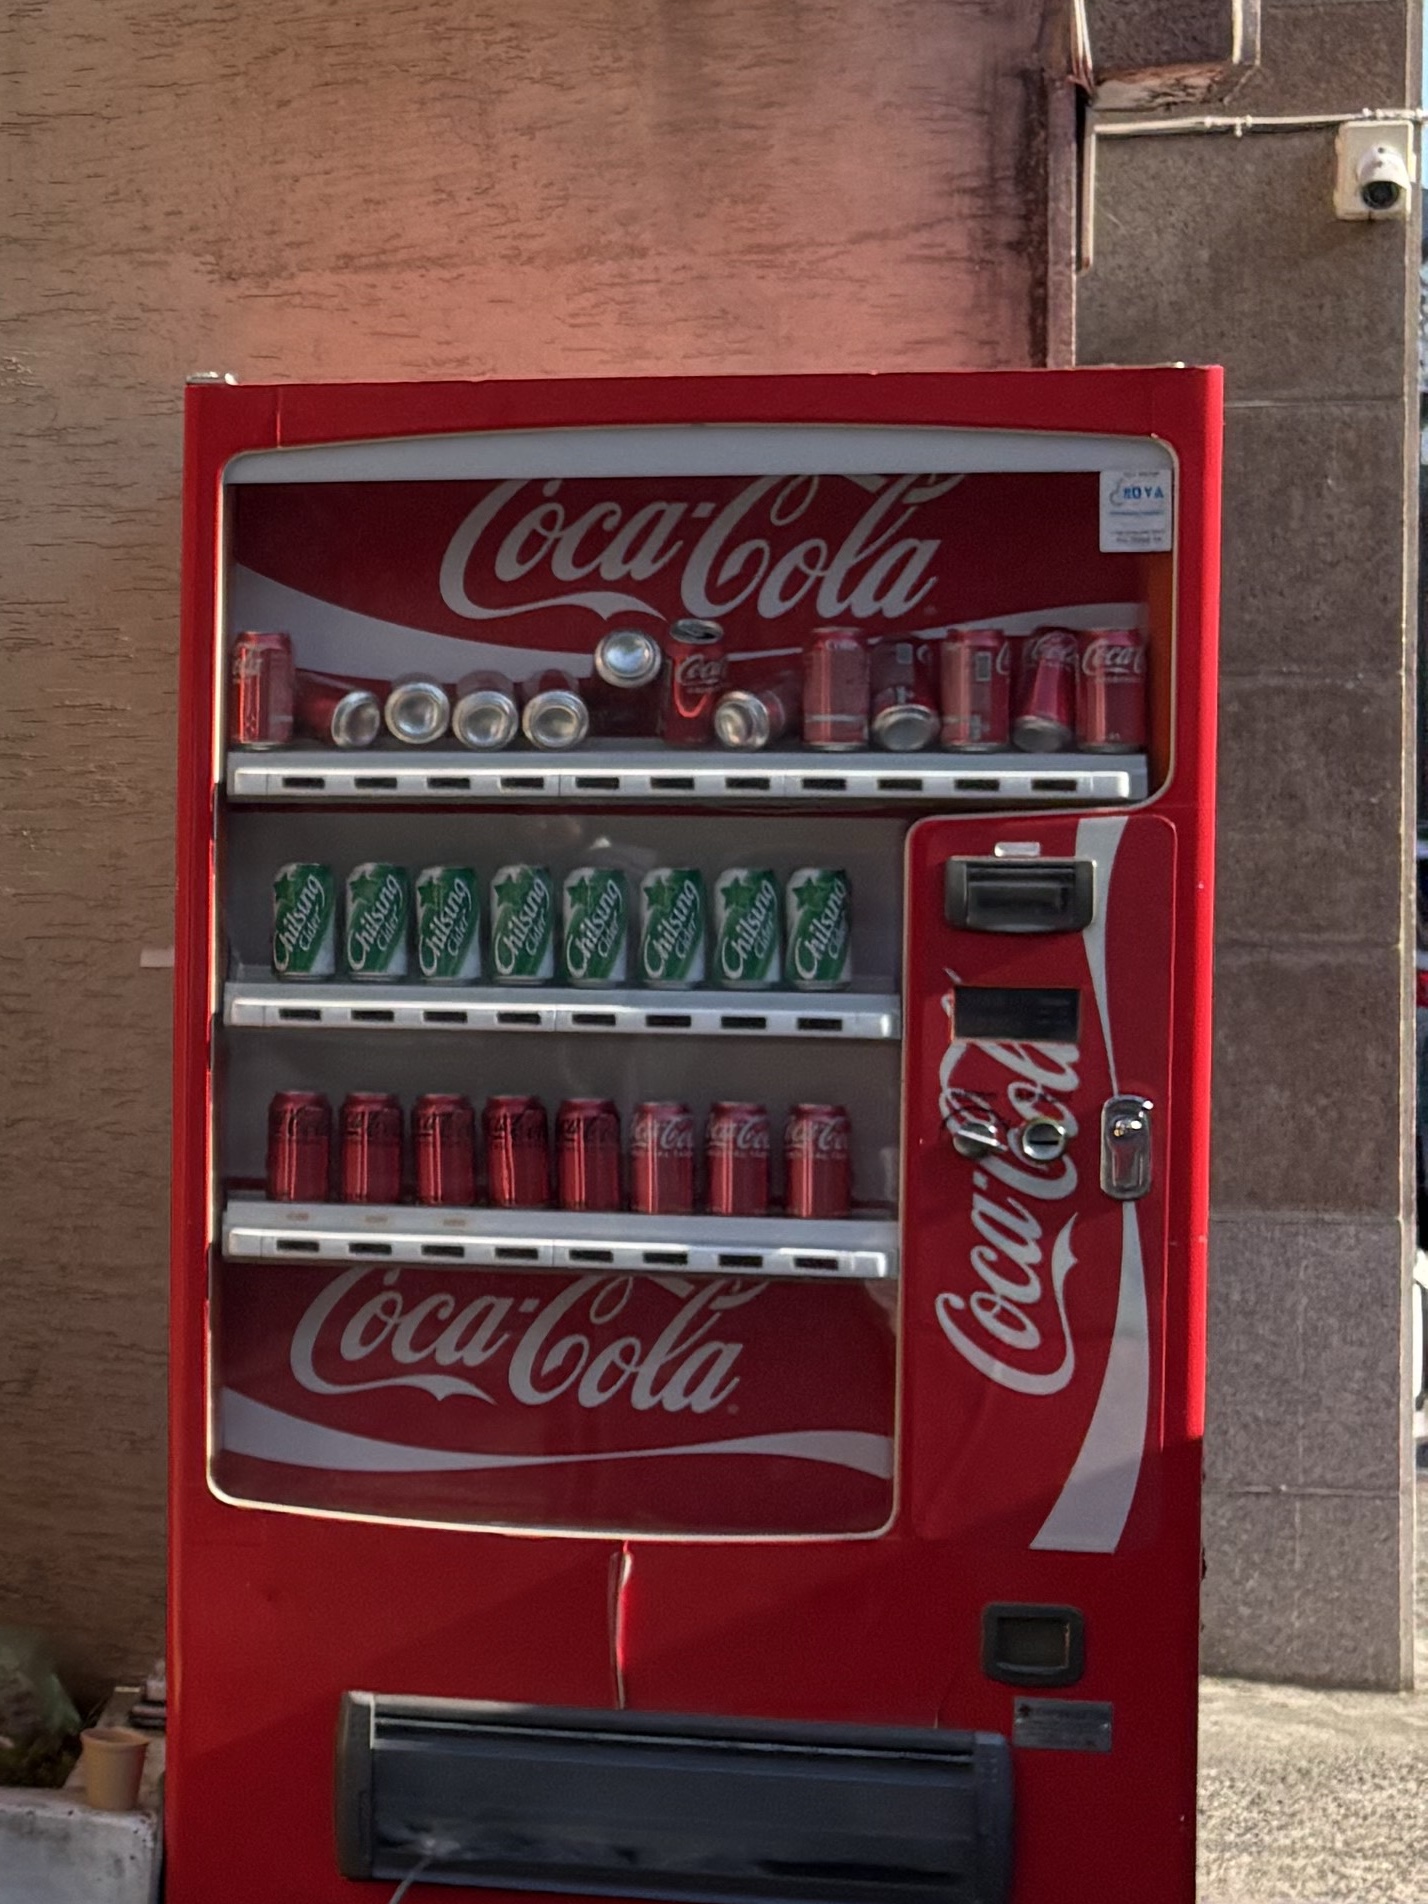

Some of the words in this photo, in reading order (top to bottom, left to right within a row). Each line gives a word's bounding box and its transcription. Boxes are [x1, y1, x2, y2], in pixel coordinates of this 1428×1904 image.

[439, 473, 964, 623] Coca-Cola
[273, 874, 325, 972] Chilsung
[347, 874, 403, 971] Chilsung
[418, 877, 472, 977] Chilsung
[494, 877, 549, 976] Chilsung
[566, 879, 622, 979] Chilsung
[644, 879, 700, 979] Chilsung
[721, 879, 777, 980] Chilsung
[289, 1265, 766, 1414] Coca-Cola
